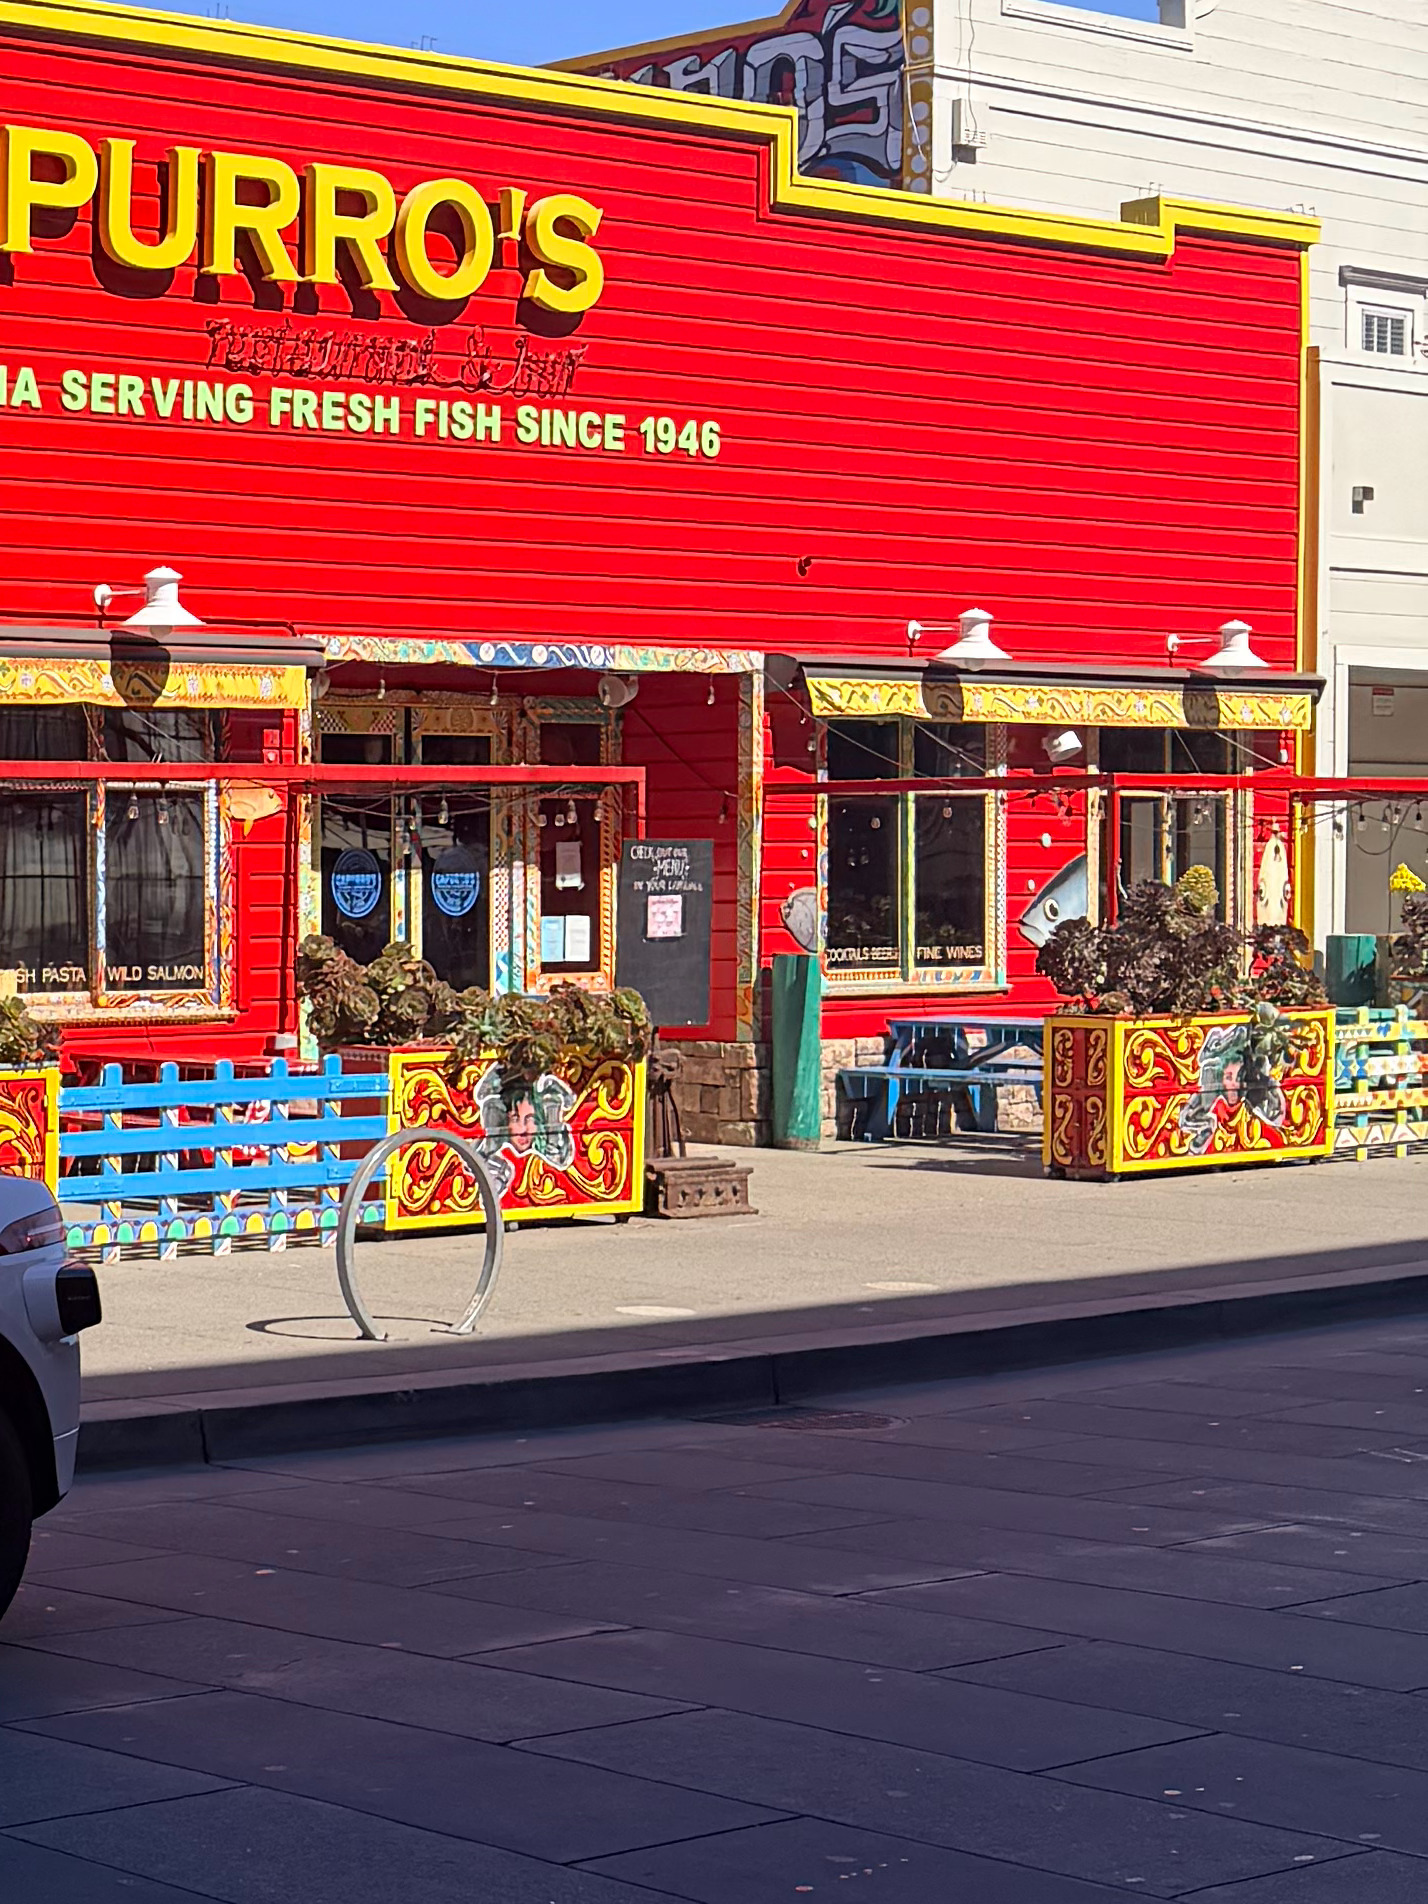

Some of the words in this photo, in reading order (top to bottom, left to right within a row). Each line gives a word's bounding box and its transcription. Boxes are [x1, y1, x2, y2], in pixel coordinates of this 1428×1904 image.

[62, 370, 254, 423] SERVING
[270, 387, 400, 434] FRESH
[415, 398, 501, 442] FISH
[516, 405, 626, 451] SINCE
[639, 416, 722, 457] 1946
[916, 946, 943, 960] FINE
[947, 945, 983, 959] WINES
[42, 967, 87, 982] PASTA
[107, 965, 143, 982] WILD
[147, 964, 204, 981] SALMON
